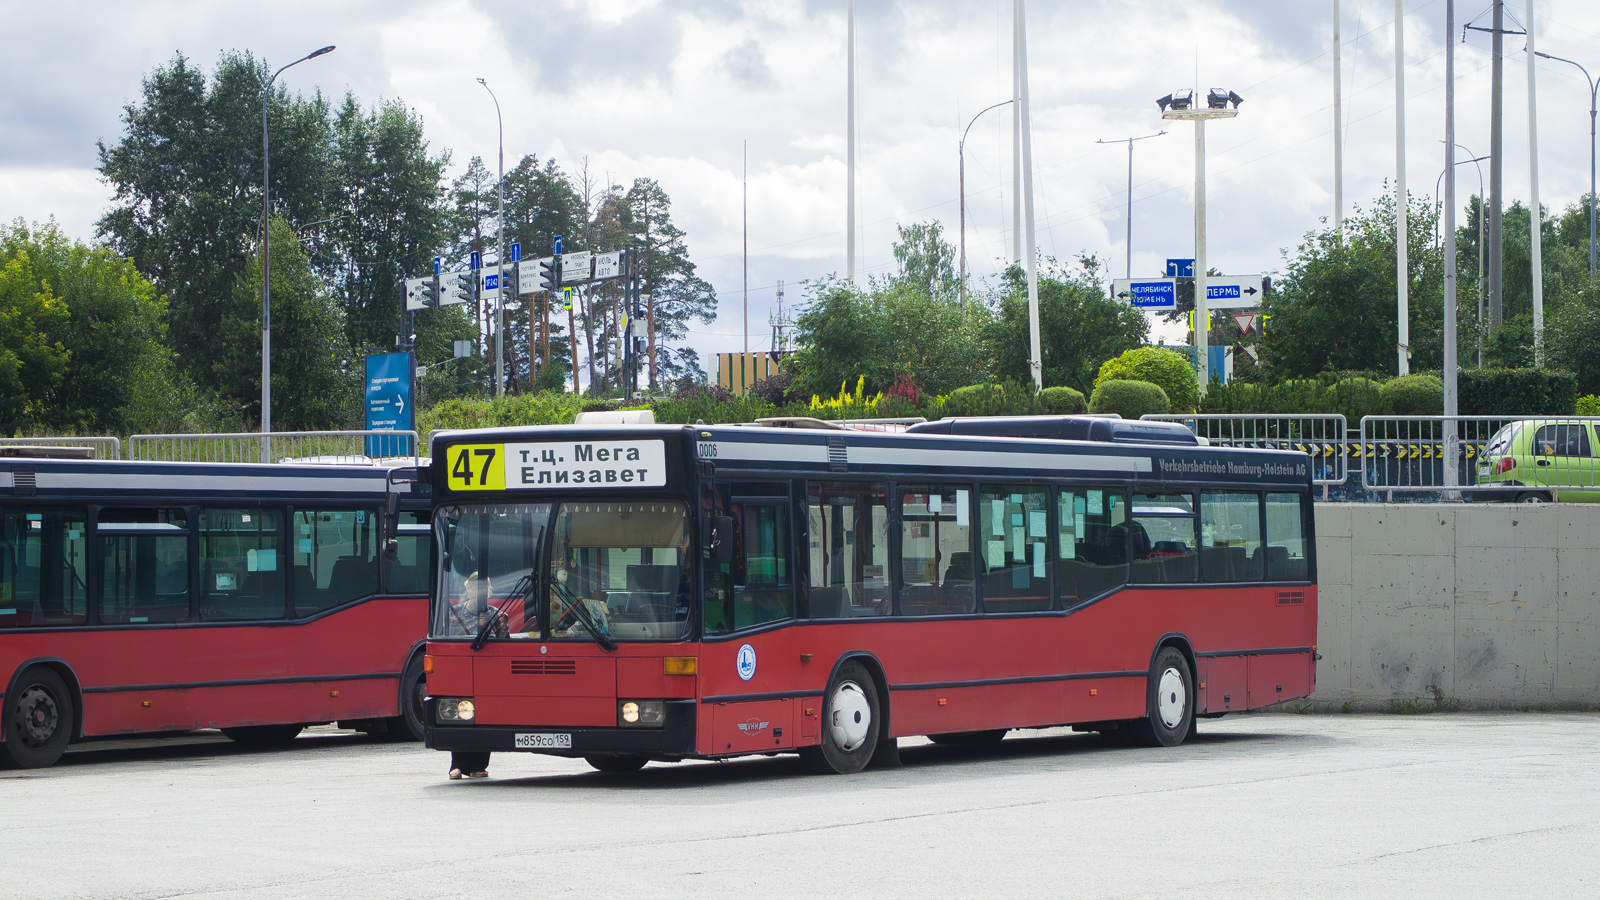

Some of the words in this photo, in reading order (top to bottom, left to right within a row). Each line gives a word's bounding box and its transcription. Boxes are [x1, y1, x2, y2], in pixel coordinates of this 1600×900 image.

[598, 268, 610, 276] АВТО
[1207, 287, 1239, 297] ПЕРМЬ
[519, 450, 564, 466] т.ц.
[575, 445, 640, 462] Мега
[699, 443, 718, 457] 0006
[452, 449, 496, 485] 47
[521, 466, 648, 484] Елизавет
[1159, 459, 1226, 474] Verkehrsbetriebe
[1228, 461, 1293, 478] Hamburg-Holstein
[1295, 464, 1306, 476] AG
[555, 735, 569, 743] 159
